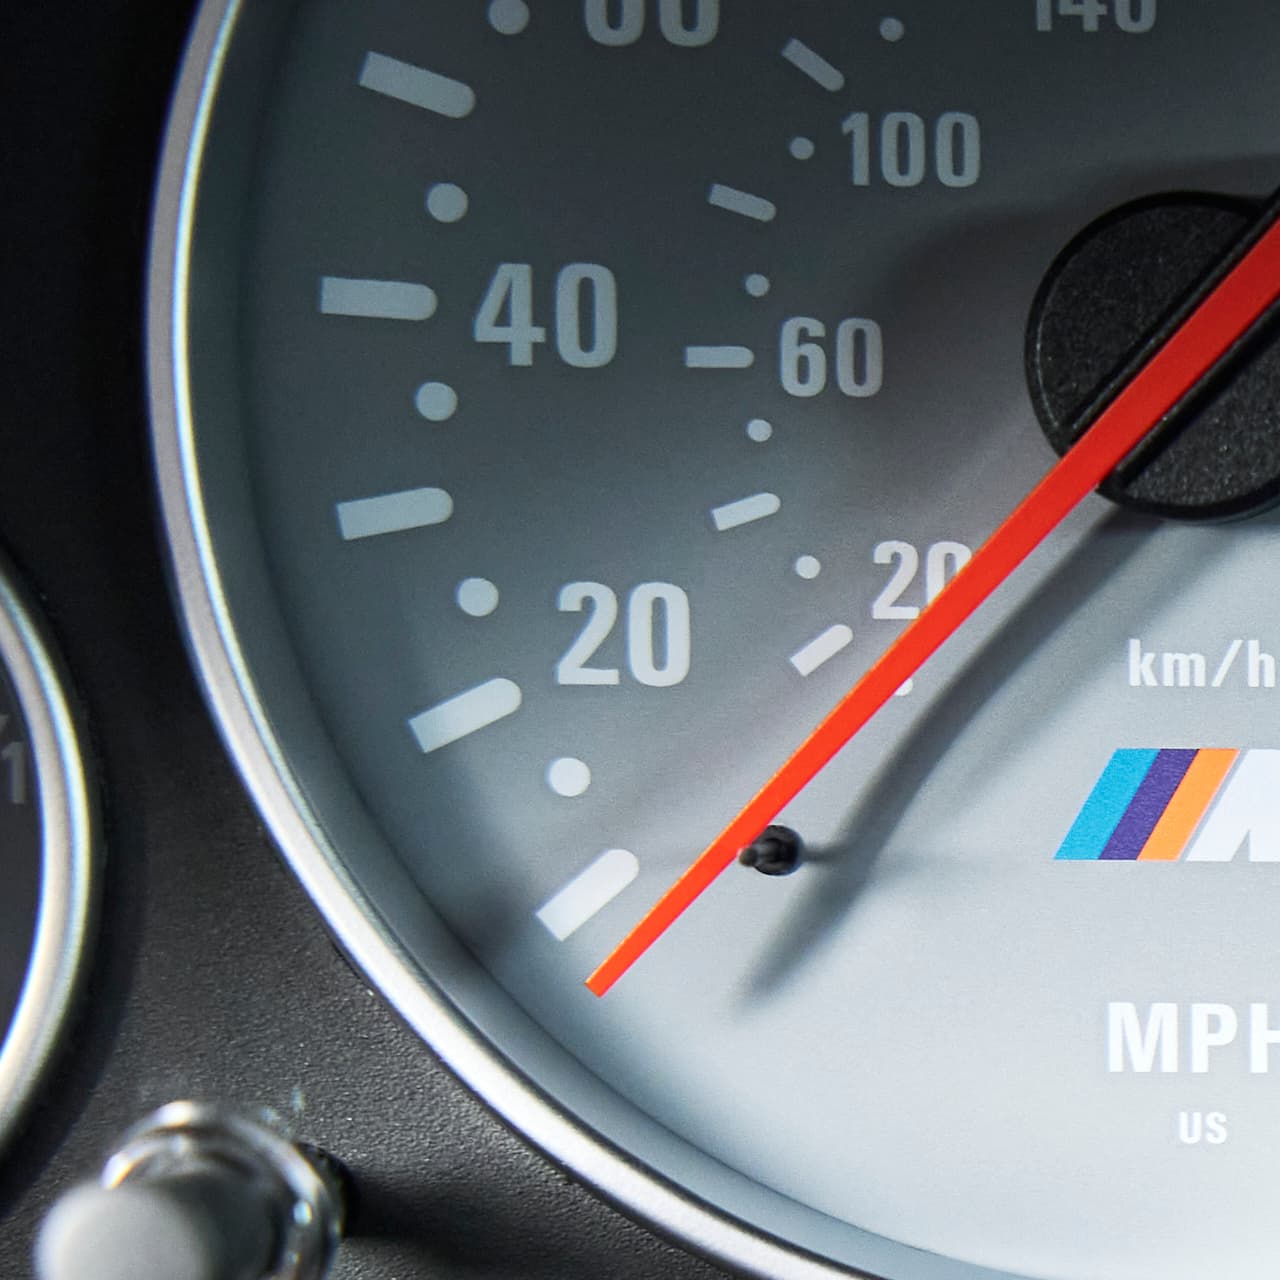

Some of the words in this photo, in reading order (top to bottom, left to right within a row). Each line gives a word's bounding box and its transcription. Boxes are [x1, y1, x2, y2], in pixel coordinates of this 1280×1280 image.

[842, 112, 981, 187] 100
[474, 263, 618, 367] 40
[779, 317, 883, 397] 60
[556, 582, 690, 687] 20
[1129, 640, 1276, 687] km/h
[1178, 1111, 1228, 1144] US
